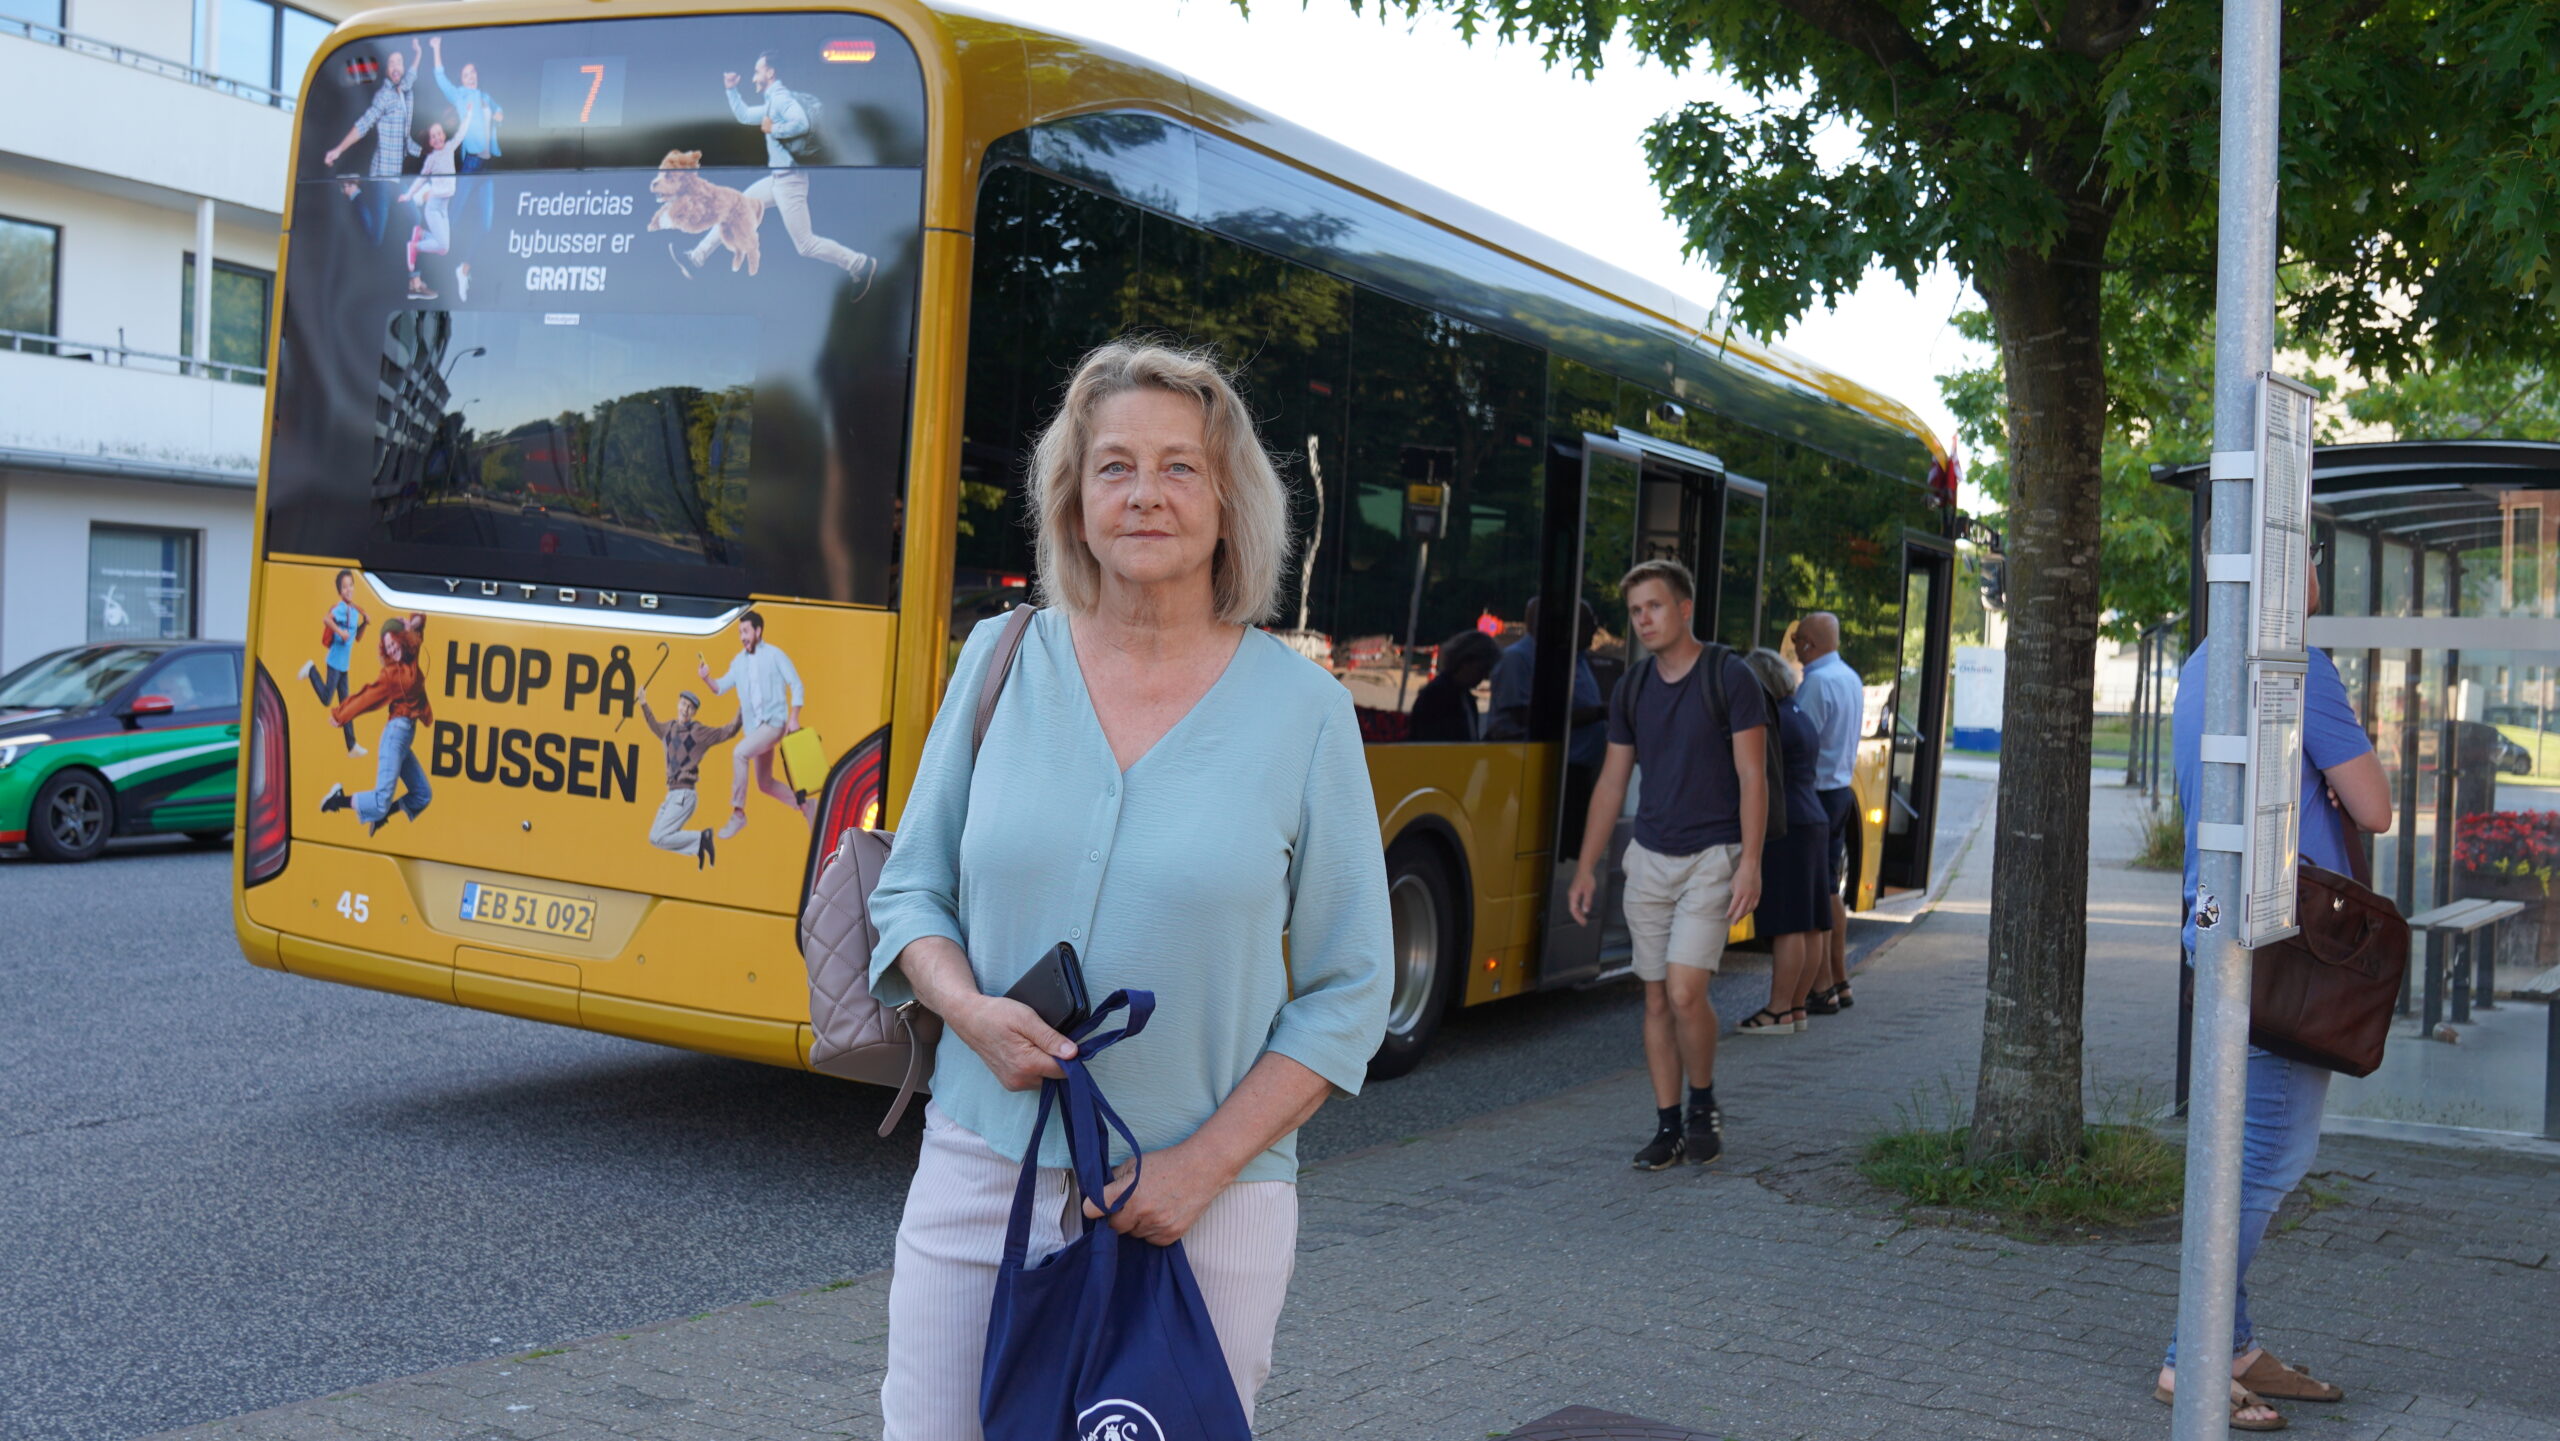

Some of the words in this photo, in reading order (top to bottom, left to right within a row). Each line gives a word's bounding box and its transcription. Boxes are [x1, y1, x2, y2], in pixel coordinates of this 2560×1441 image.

[580, 64, 604, 123] 7
[517, 190, 634, 217] Fredericias
[508, 229, 606, 259] bybusser
[611, 233, 635, 254] er
[525, 266, 607, 292] GRATIS!
[445, 578, 659, 609] YUTONG
[444, 640, 552, 706] HOP
[563, 645, 636, 718] PÅ
[431, 720, 639, 803] BUSSEN
[336, 890, 370, 924] 45
[475, 890, 509, 920] EB
[511, 896, 537, 926] 51
[546, 901, 592, 935] 092
